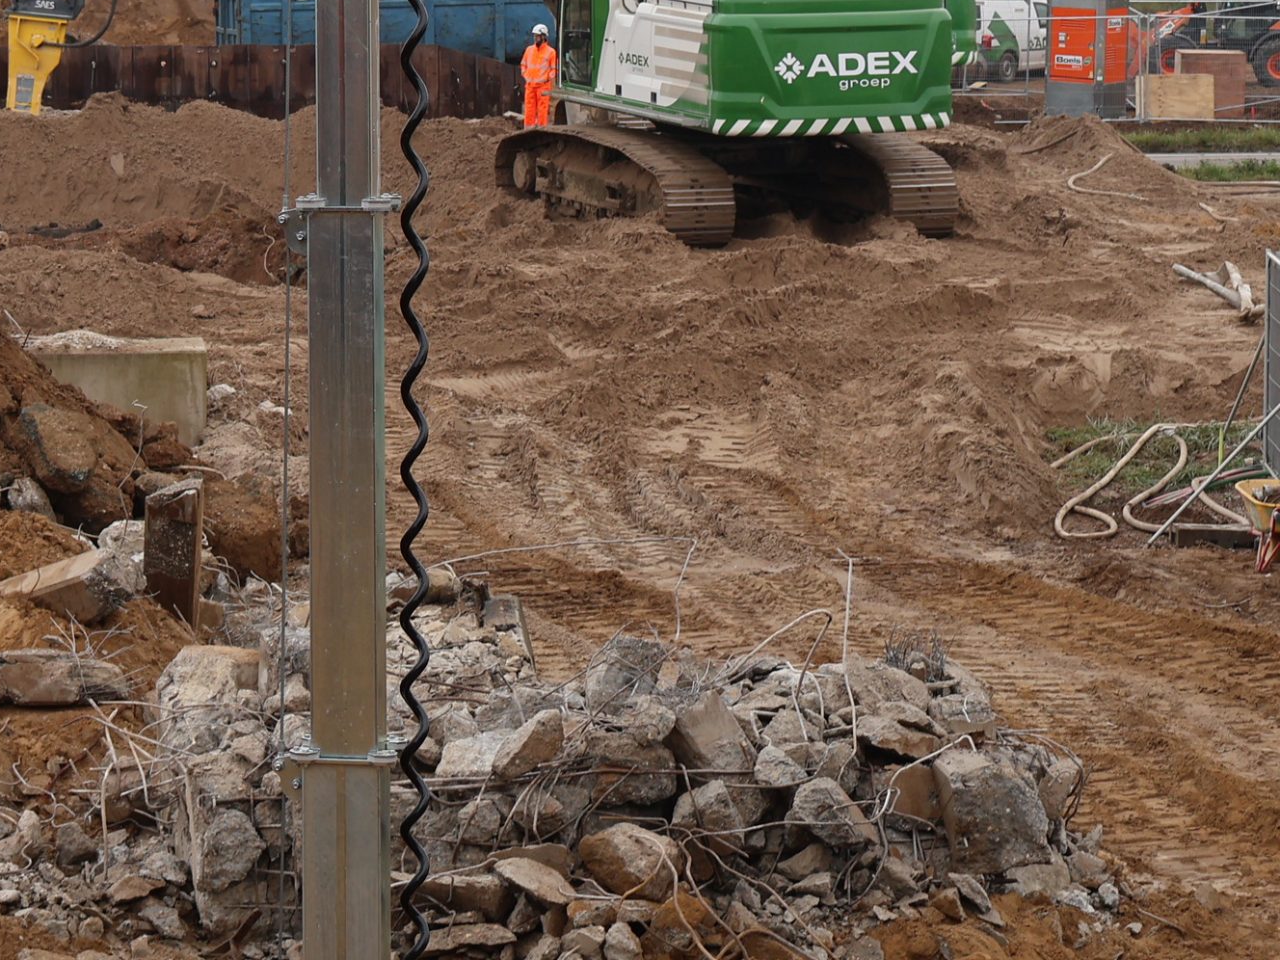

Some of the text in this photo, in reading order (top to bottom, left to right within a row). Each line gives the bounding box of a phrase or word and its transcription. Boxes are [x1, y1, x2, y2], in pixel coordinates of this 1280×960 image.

[34, 0, 55, 10] SAES
[625, 52, 650, 68] ADEX
[806, 50, 918, 78] ADEX
[839, 77, 890, 91] groep
